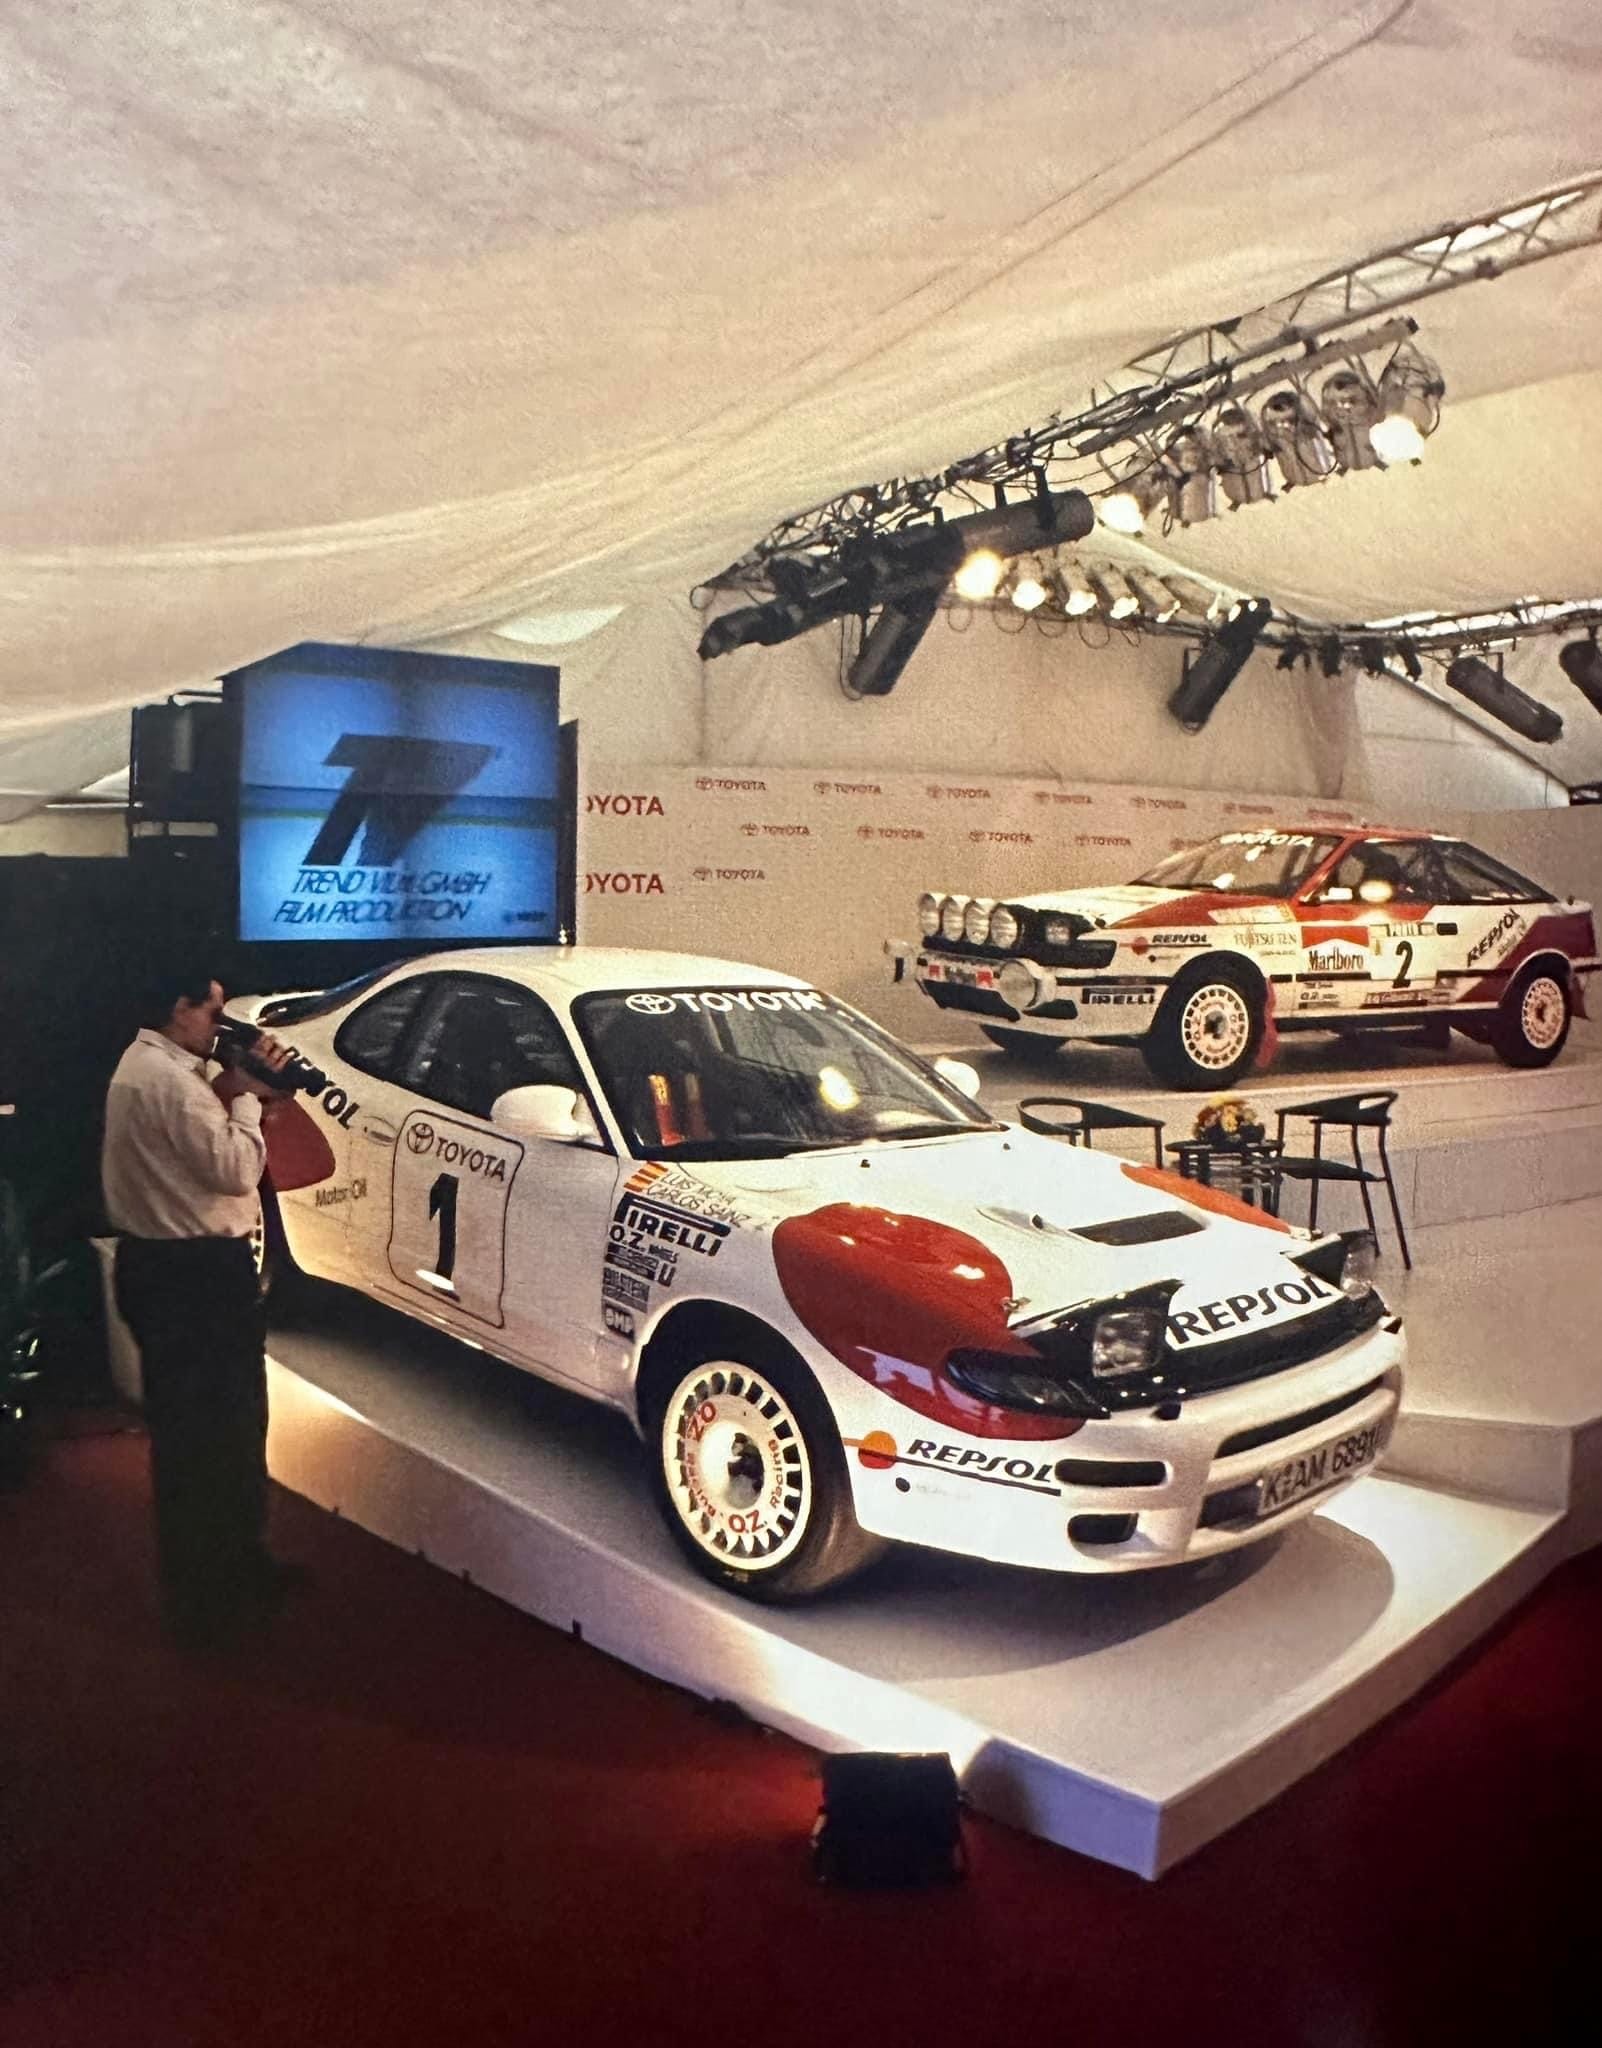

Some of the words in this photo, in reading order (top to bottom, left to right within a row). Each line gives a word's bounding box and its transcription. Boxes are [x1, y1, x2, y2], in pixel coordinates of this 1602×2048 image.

[717, 780, 767, 791] TOYOTA
[834, 783, 882, 794] TOYOTA
[947, 788, 991, 798] TOYOTA
[762, 825, 809, 836] TOYOTA
[878, 828, 925, 840] TOYOTA
[988, 831, 1033, 843] TOYOTA
[293, 869, 366, 894] TREND
[716, 869, 765, 880] TOYOTA
[1152, 934, 1207, 944] REPSOL
[1466, 907, 1521, 968] REPSOL
[1308, 946, 1364, 971] Marlboro
[1392, 940, 1413, 989] 2
[672, 991, 827, 1013] TOYOTA
[1081, 987, 1155, 1005] PIRELLI
[435, 1138, 506, 1182] TOYOTA
[613, 1192, 731, 1257] PIRELLI
[416, 1172, 461, 1303] 1
[1166, 1276, 1332, 1345] REPSOL
[907, 1439, 1054, 1482] REPSOL
